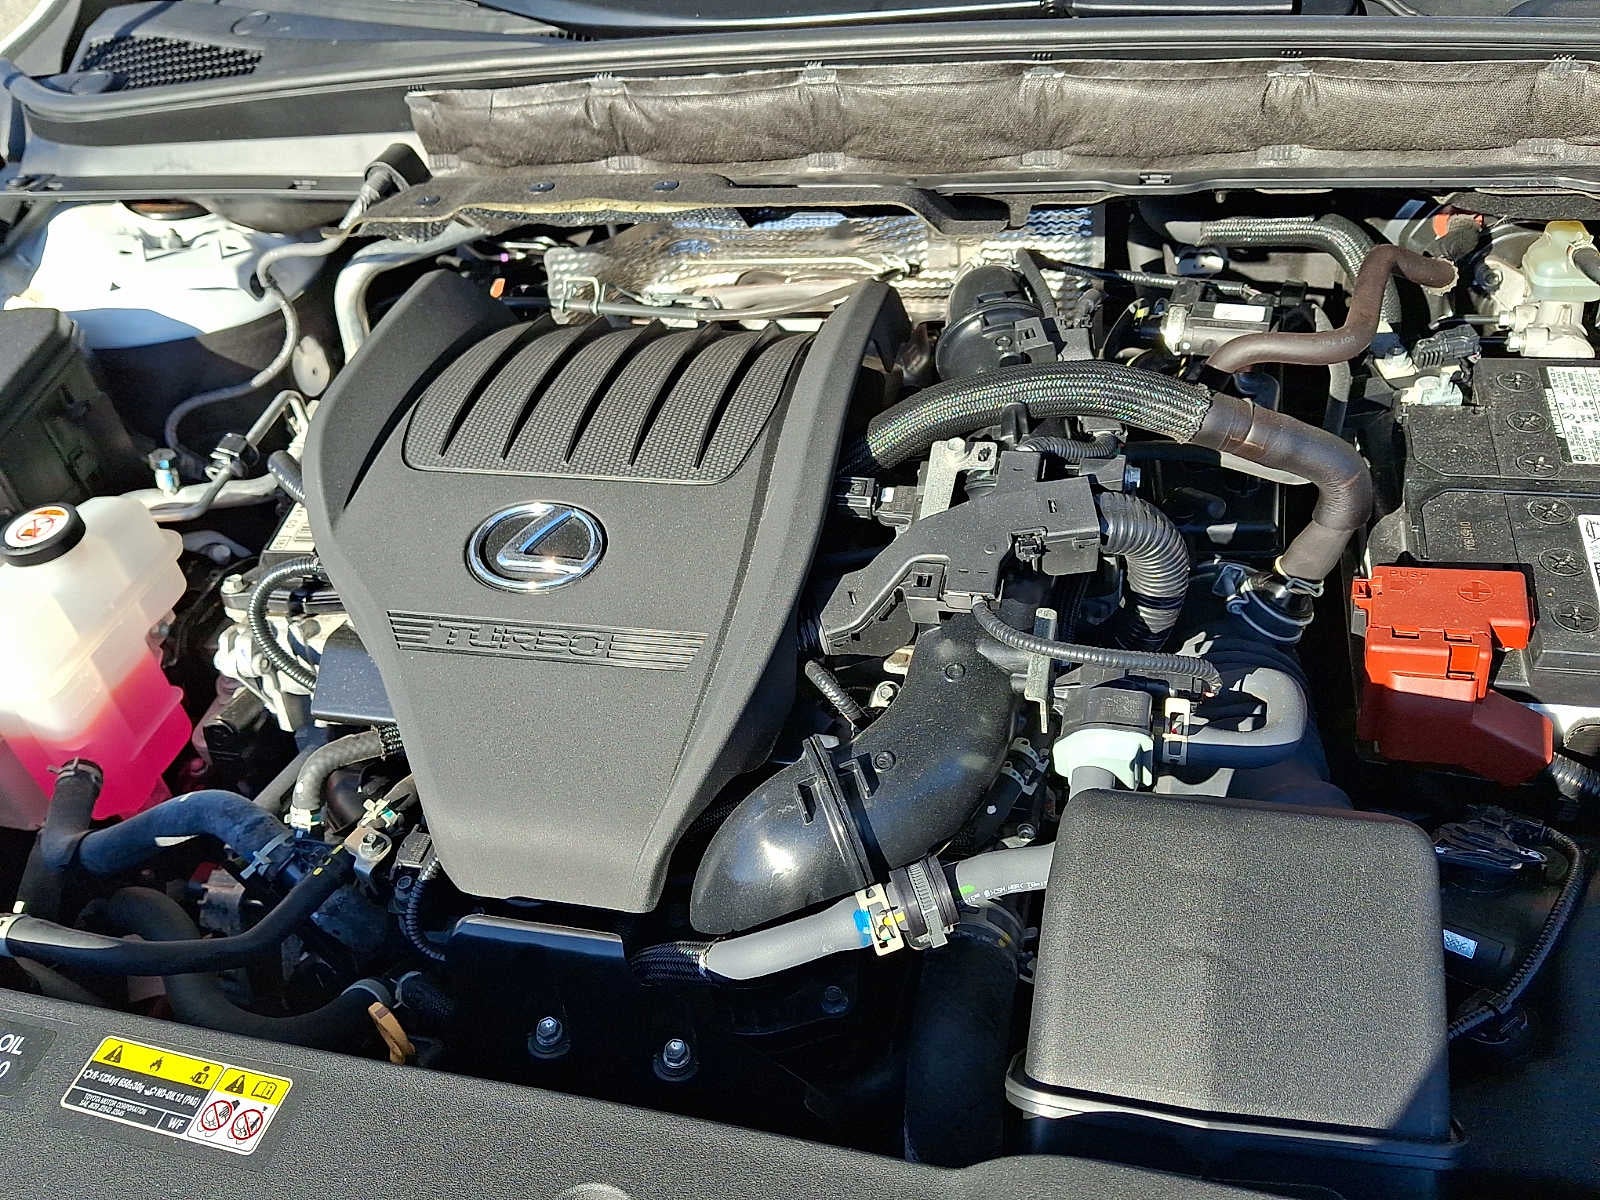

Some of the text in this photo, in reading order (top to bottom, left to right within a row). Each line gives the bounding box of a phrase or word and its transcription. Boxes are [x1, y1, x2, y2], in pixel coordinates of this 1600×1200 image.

[1389, 569, 1430, 579] PUSH
[436, 621, 605, 657] TURBO
[0, 1033, 25, 1056] OIL
[83, 1092, 102, 1105] TOYOTA
[100, 1097, 116, 1108] MOTOR
[167, 1116, 186, 1130] WF
